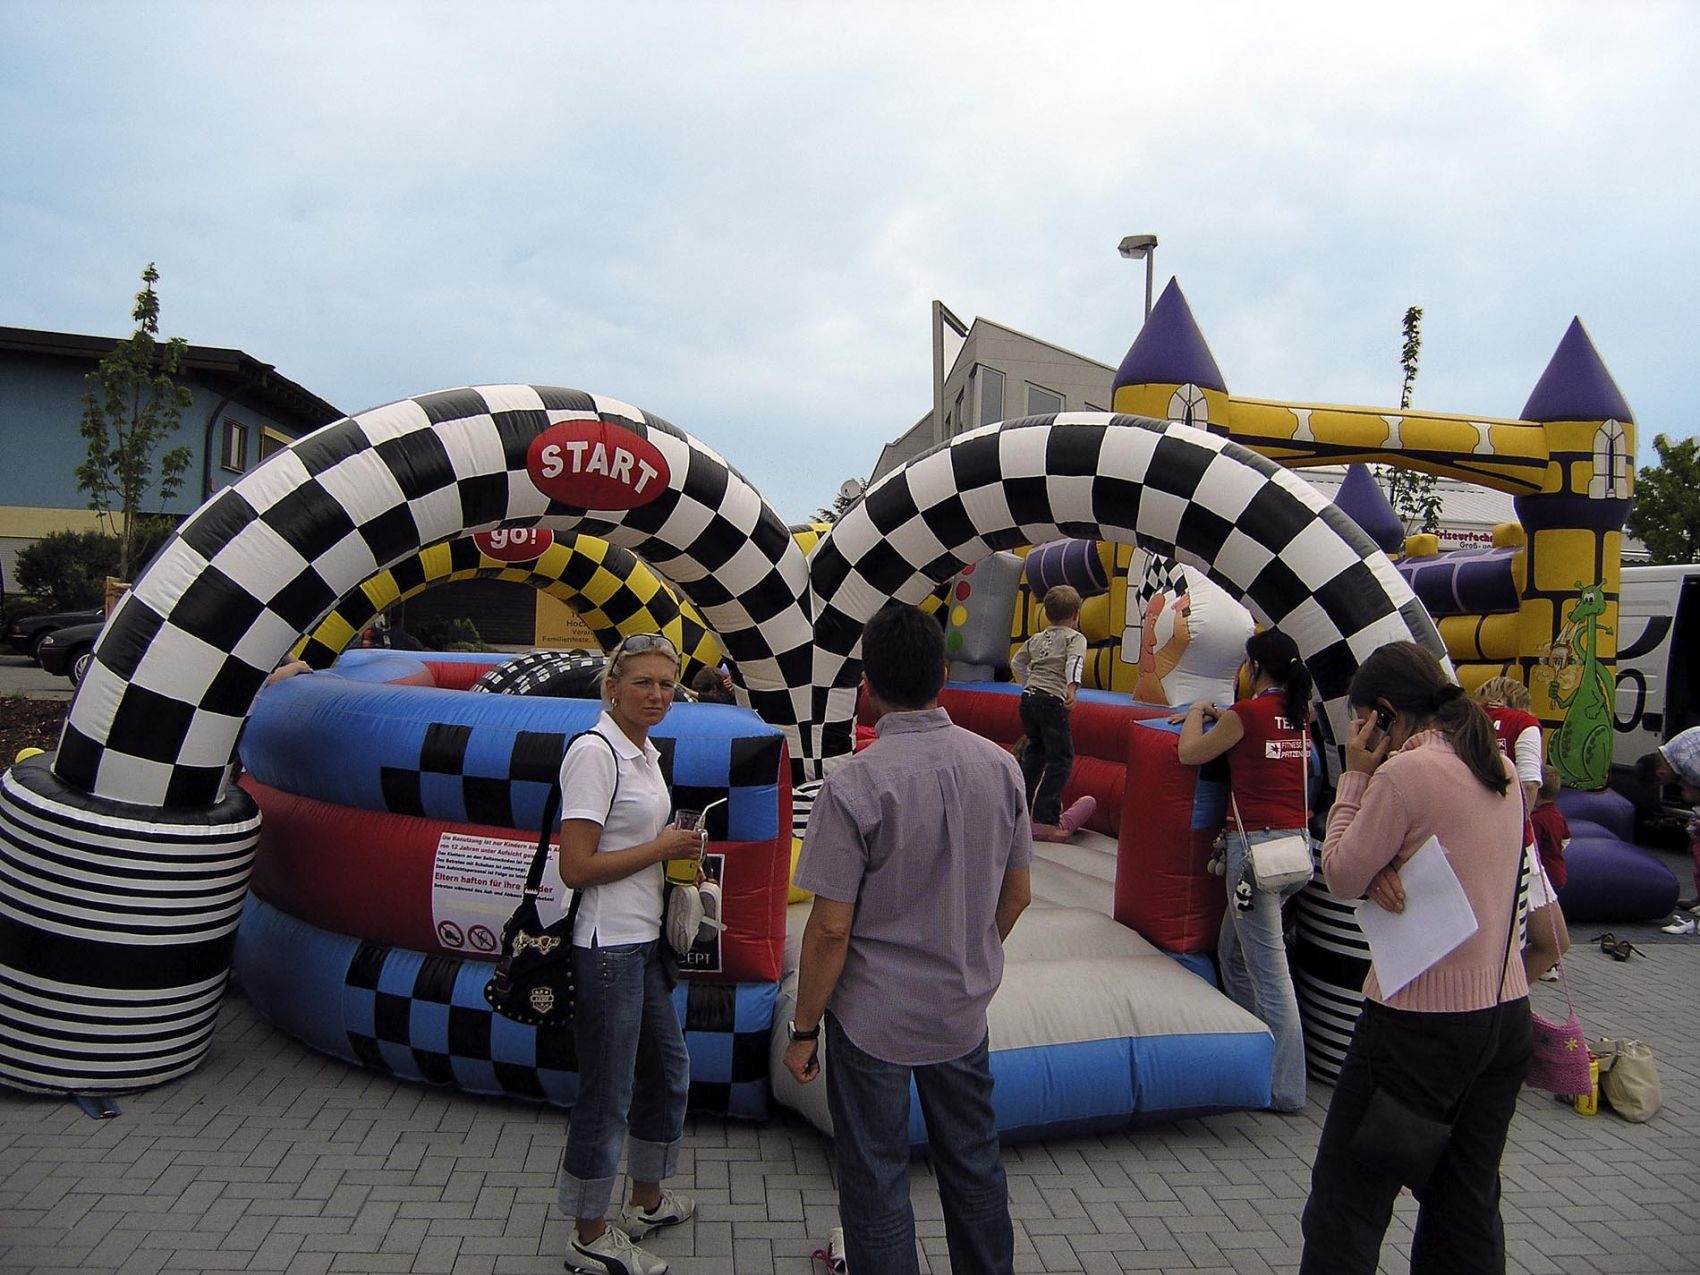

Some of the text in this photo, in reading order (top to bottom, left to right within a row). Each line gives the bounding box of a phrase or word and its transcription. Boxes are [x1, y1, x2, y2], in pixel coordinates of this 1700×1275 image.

[541, 441, 658, 494] START
[490, 528, 537, 549] go!
[452, 836, 482, 845] Benutzung
[497, 849, 522, 858] Aufsicht
[434, 872, 459, 882] Eltern
[460, 875, 488, 886] haften
[489, 879, 502, 888] für
[503, 880, 521, 890] ihre
